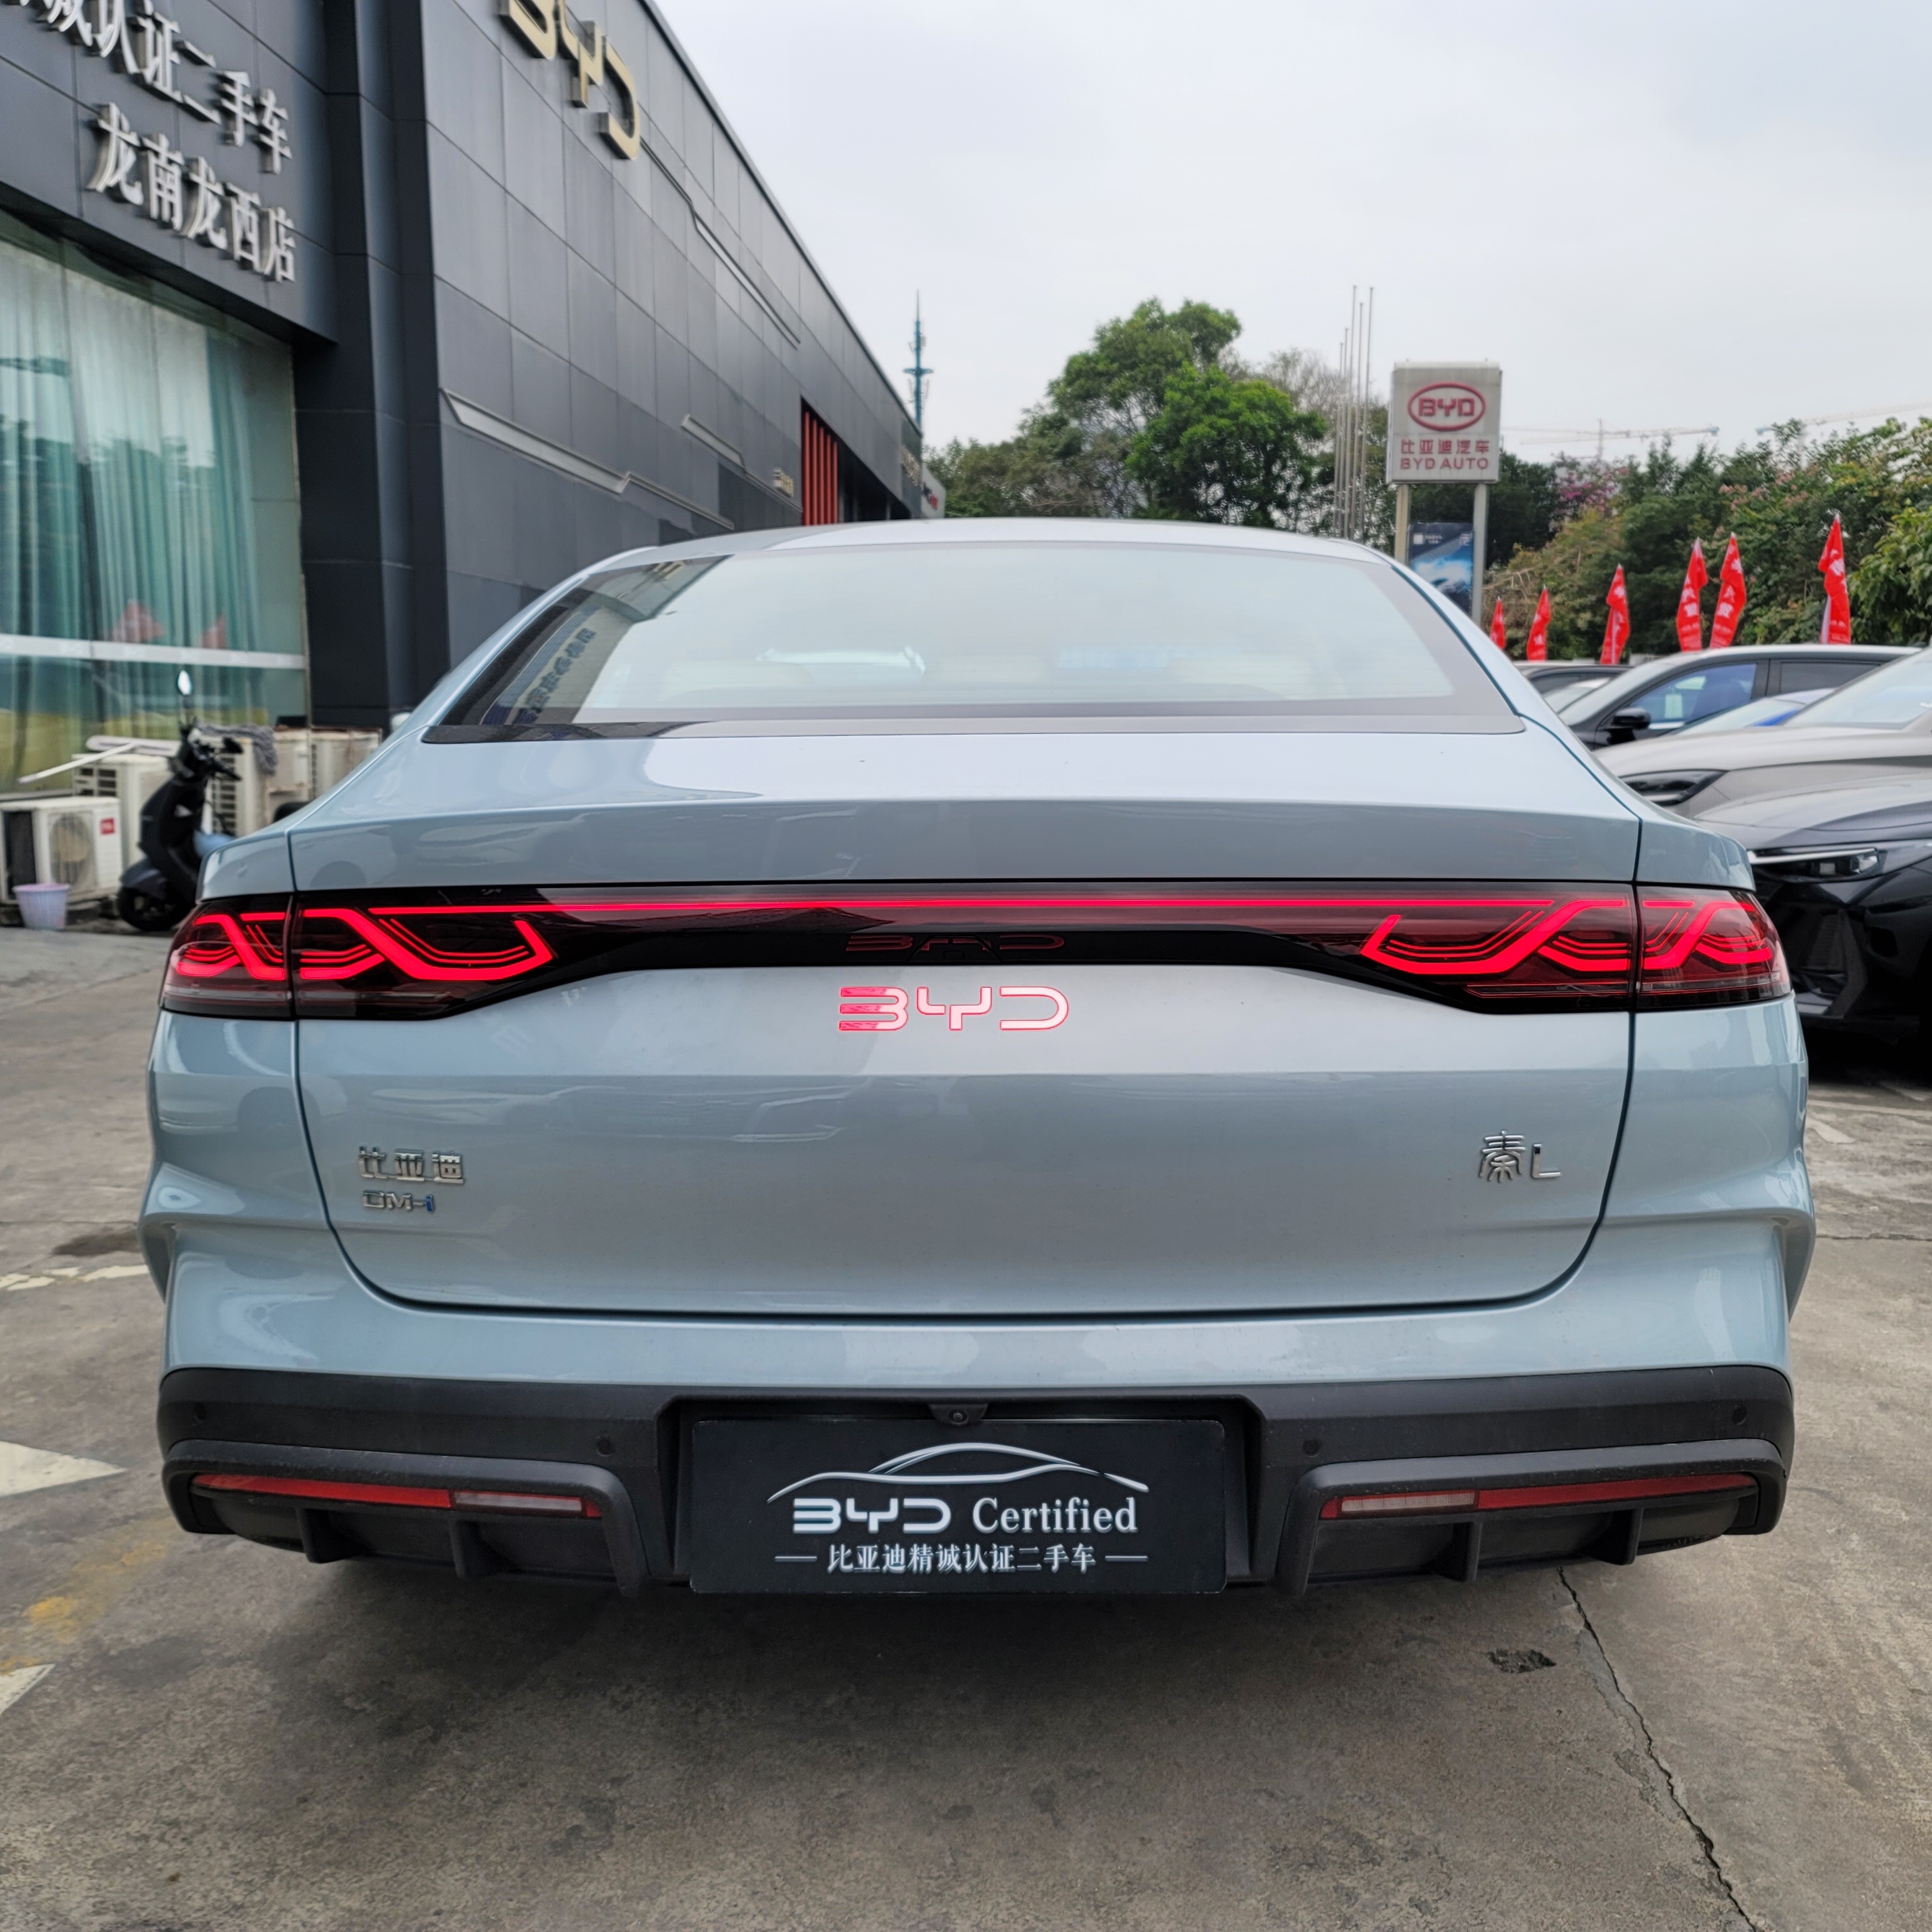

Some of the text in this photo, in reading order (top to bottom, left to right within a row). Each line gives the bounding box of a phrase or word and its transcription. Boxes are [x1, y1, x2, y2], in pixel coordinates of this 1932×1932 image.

[86, 101, 296, 283] 龙南龙西店
[1418, 397, 1475, 417] BYD
[1400, 438, 1491, 455] 比亚迪汽车
[1400, 457, 1490, 470] BYD AUTO
[838, 986, 1069, 1031] BYD
[358, 1146, 465, 1184] 比亚迪
[792, 1497, 1138, 1534] BYD Certified
[827, 1543, 1097, 1574] 比亚迪精诚认证二手车
